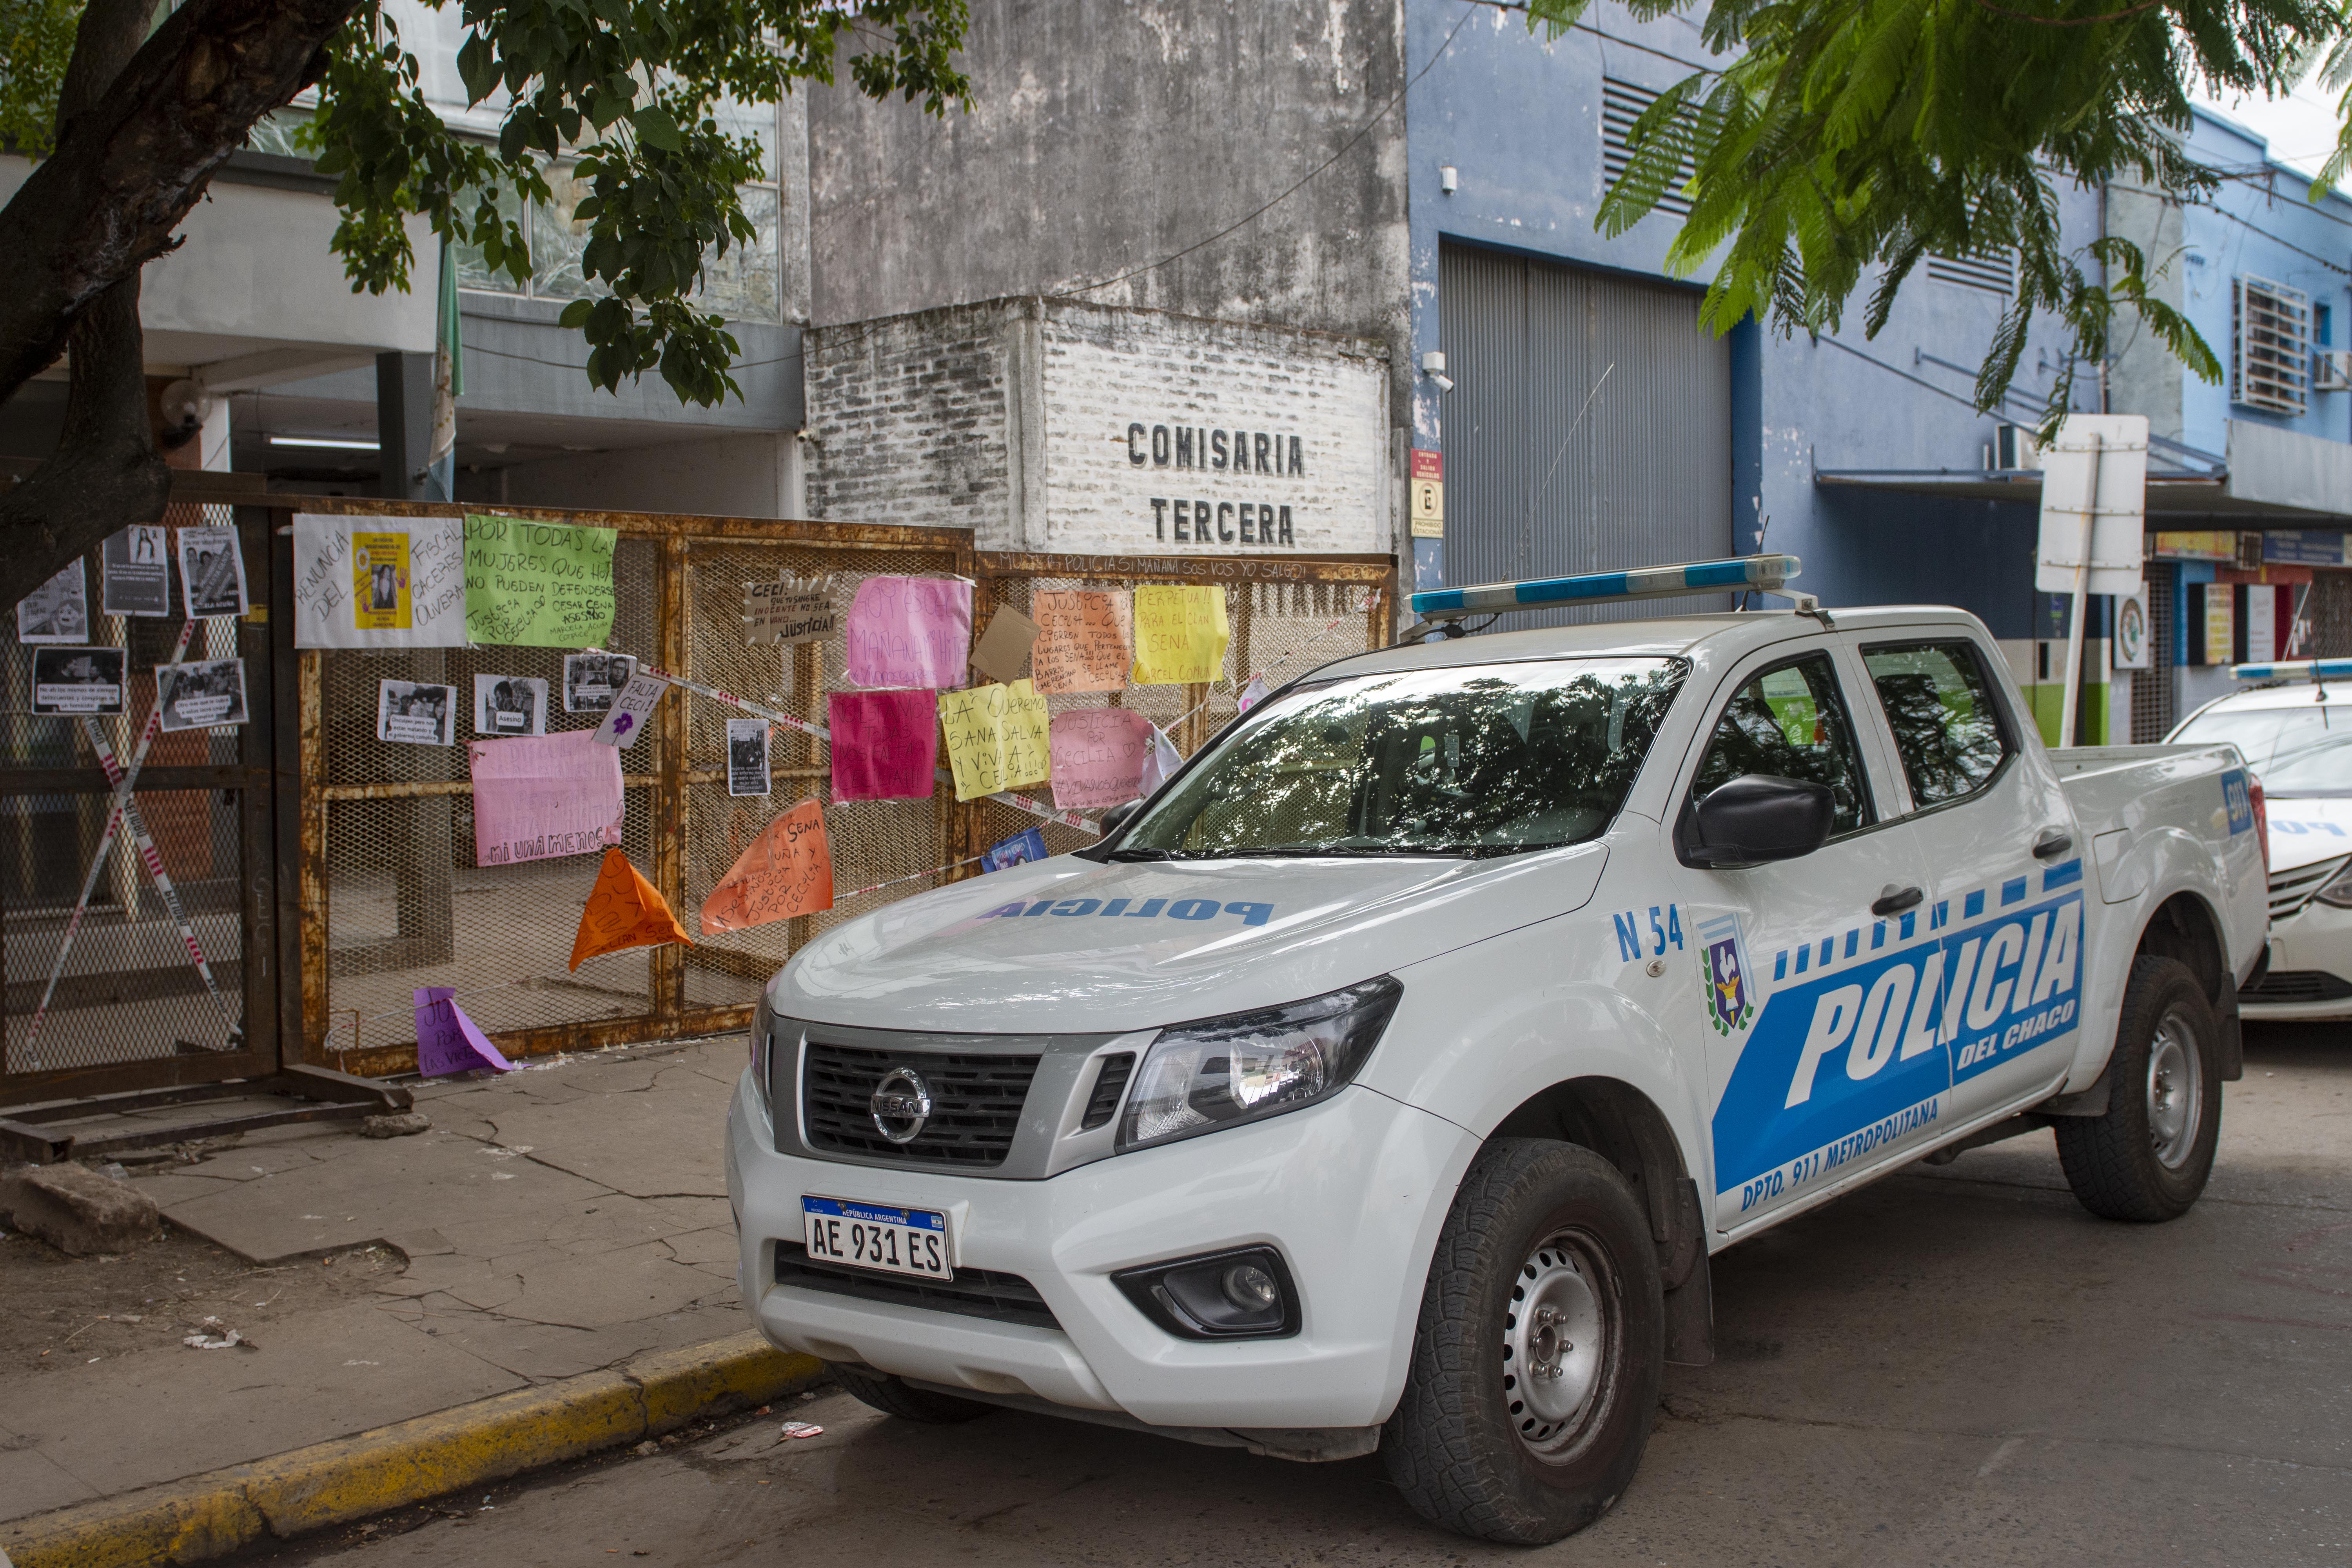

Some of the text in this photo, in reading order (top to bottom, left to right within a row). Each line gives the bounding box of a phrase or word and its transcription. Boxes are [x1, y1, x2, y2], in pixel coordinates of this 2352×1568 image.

[1128, 423, 1305, 479] COMISARIA
[1150, 497, 1296, 548] TERCERA
[470, 516, 507, 542] POR
[520, 524, 584, 551] TODAS
[552, 558, 584, 579] QUE
[1065, 554, 1116, 572] POLICIA
[1182, 561, 1207, 575] SOS
[1210, 561, 1235, 577] VOS
[1240, 560, 1257, 577] YO
[465, 575, 485, 589] NO
[495, 574, 545, 593] PUEDEN
[312, 580, 348, 622] DEL
[754, 601, 830, 615] INOCENTE NO SEA
[771, 597, 784, 606] QUE
[793, 593, 820, 604] SANGRE
[753, 617, 765, 628] EN
[1138, 612, 1210, 629] PARA EL CLAN
[1038, 644, 1071, 655] LUGARES
[1074, 643, 1089, 652] QUE
[1135, 662, 1211, 684] CARCEL COMUN
[628, 680, 659, 698] FALTA
[1053, 679, 1073, 691] SENA
[498, 715, 522, 724] Asesino
[1002, 720, 1043, 741] SALVA
[1086, 731, 1105, 745] POR
[788, 819, 820, 842] SENA
[1613, 903, 1683, 962] N 54
[1784, 898, 2082, 1109] POLICIA
[1957, 998, 2075, 1071] DEL CHACO
[872, 1100, 919, 1113] NISSAN
[1740, 1098, 1938, 1212] DPTO. 911 METROPOLITANA
[842, 1207, 907, 1225] REPÚBLICA ARGENTINA
[813, 1218, 941, 1272] AE 931 ES
